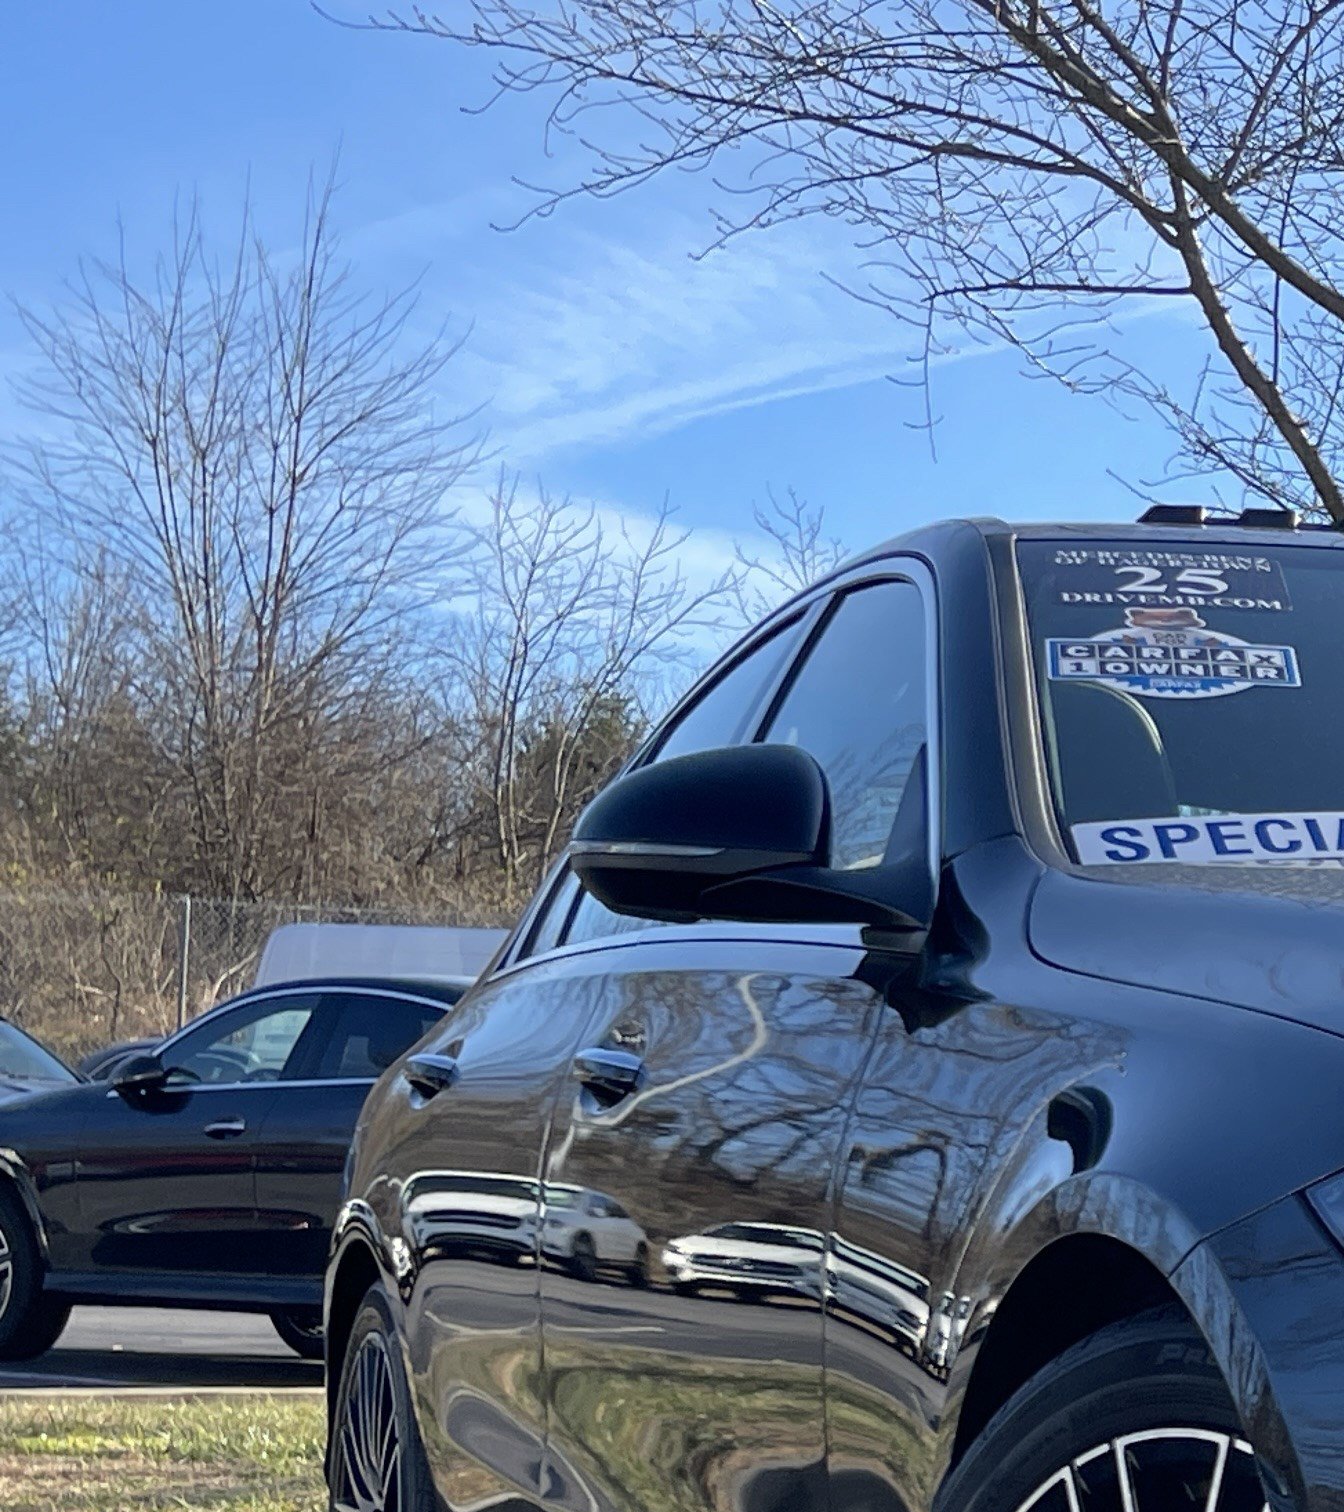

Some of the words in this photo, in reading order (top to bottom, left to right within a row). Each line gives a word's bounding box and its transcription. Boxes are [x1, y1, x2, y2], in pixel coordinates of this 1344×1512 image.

[1114, 566, 1229, 595] 25
[1061, 591, 1283, 611] DRIVEMB.COM
[1067, 644, 1277, 666] CARFAX
[1069, 661, 1090, 674] 1
[1105, 661, 1279, 680] OWNER
